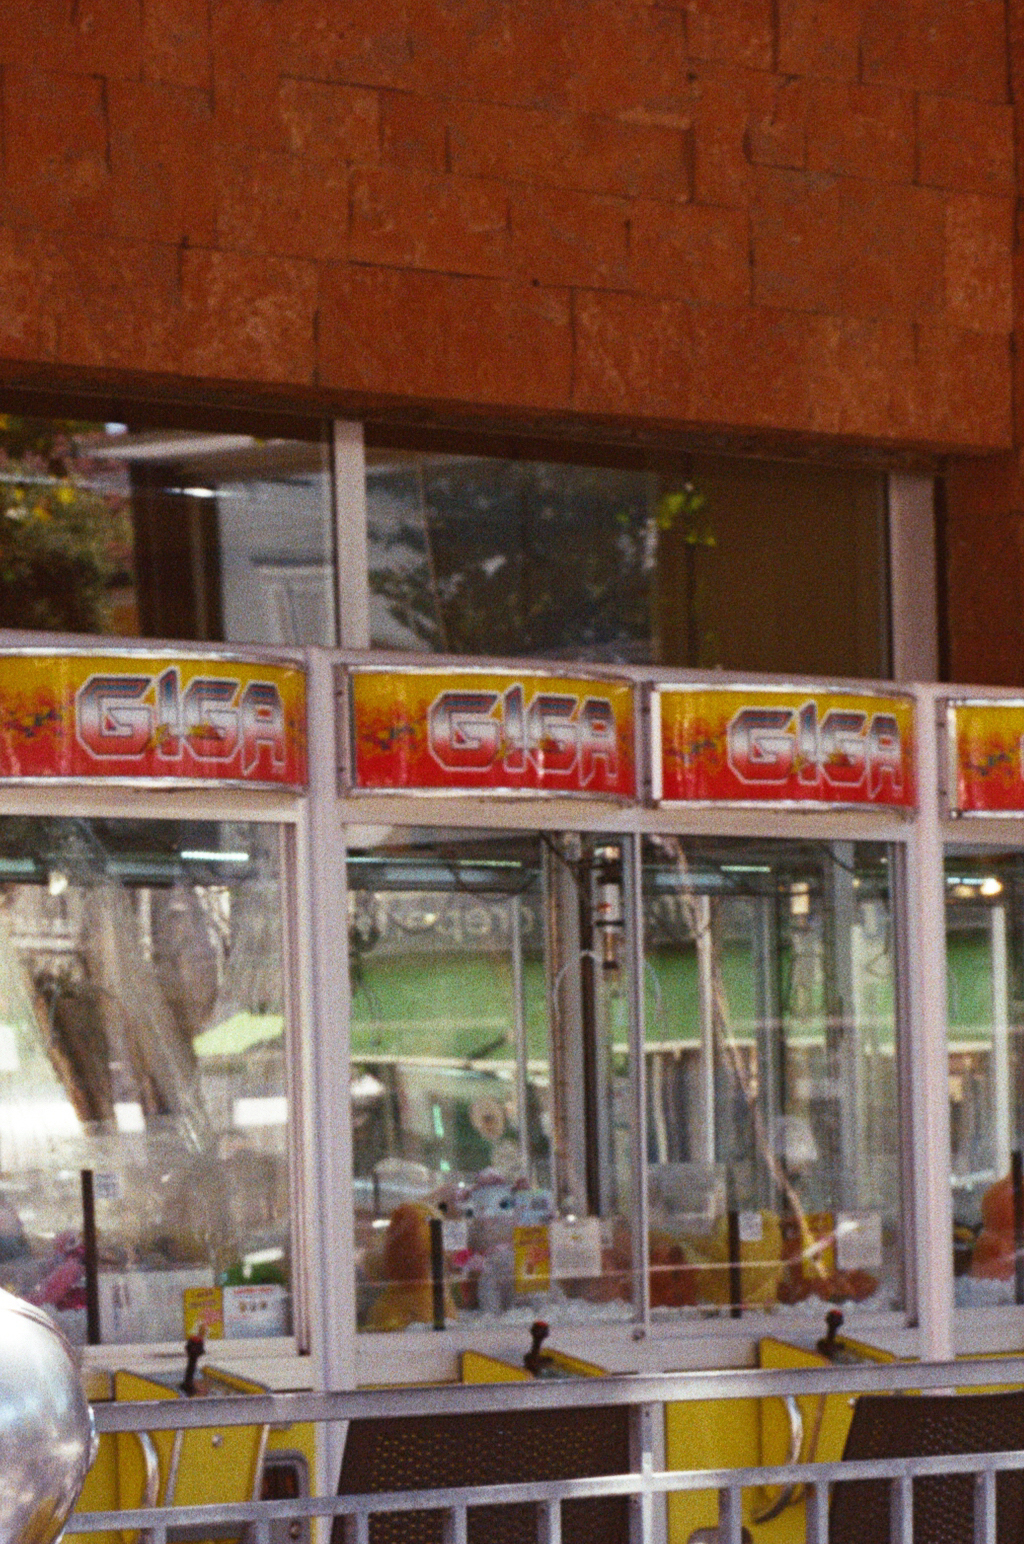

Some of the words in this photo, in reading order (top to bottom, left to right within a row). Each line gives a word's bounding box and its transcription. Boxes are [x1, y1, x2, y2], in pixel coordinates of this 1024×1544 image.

[76, 666, 286, 775] GIGA
[428, 682, 618, 787] GIGA
[727, 700, 904, 798] GIGA
